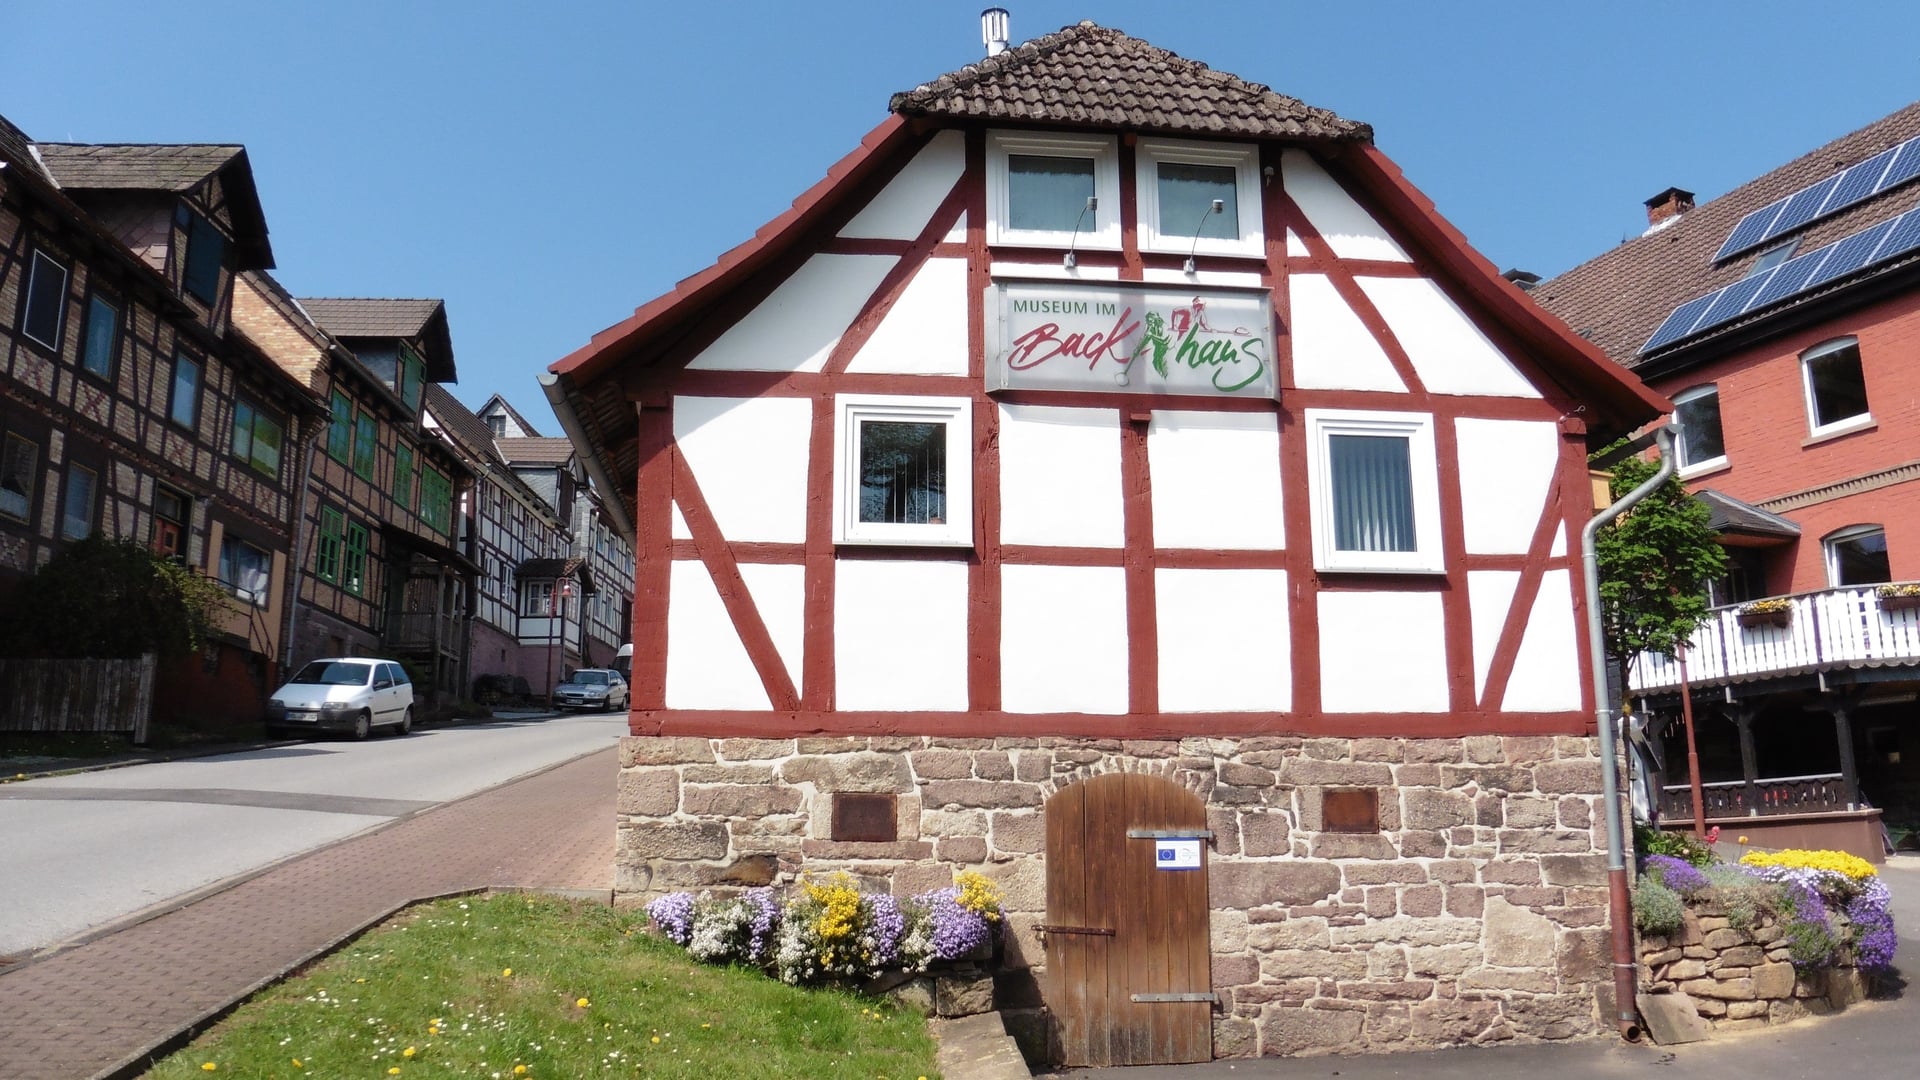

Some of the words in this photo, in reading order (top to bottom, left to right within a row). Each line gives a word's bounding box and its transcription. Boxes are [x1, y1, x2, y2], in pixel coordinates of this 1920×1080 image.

[1013, 300, 1088, 314] MUSEUM
[1096, 303, 1116, 315] IM
[1007, 306, 1140, 371] Back
